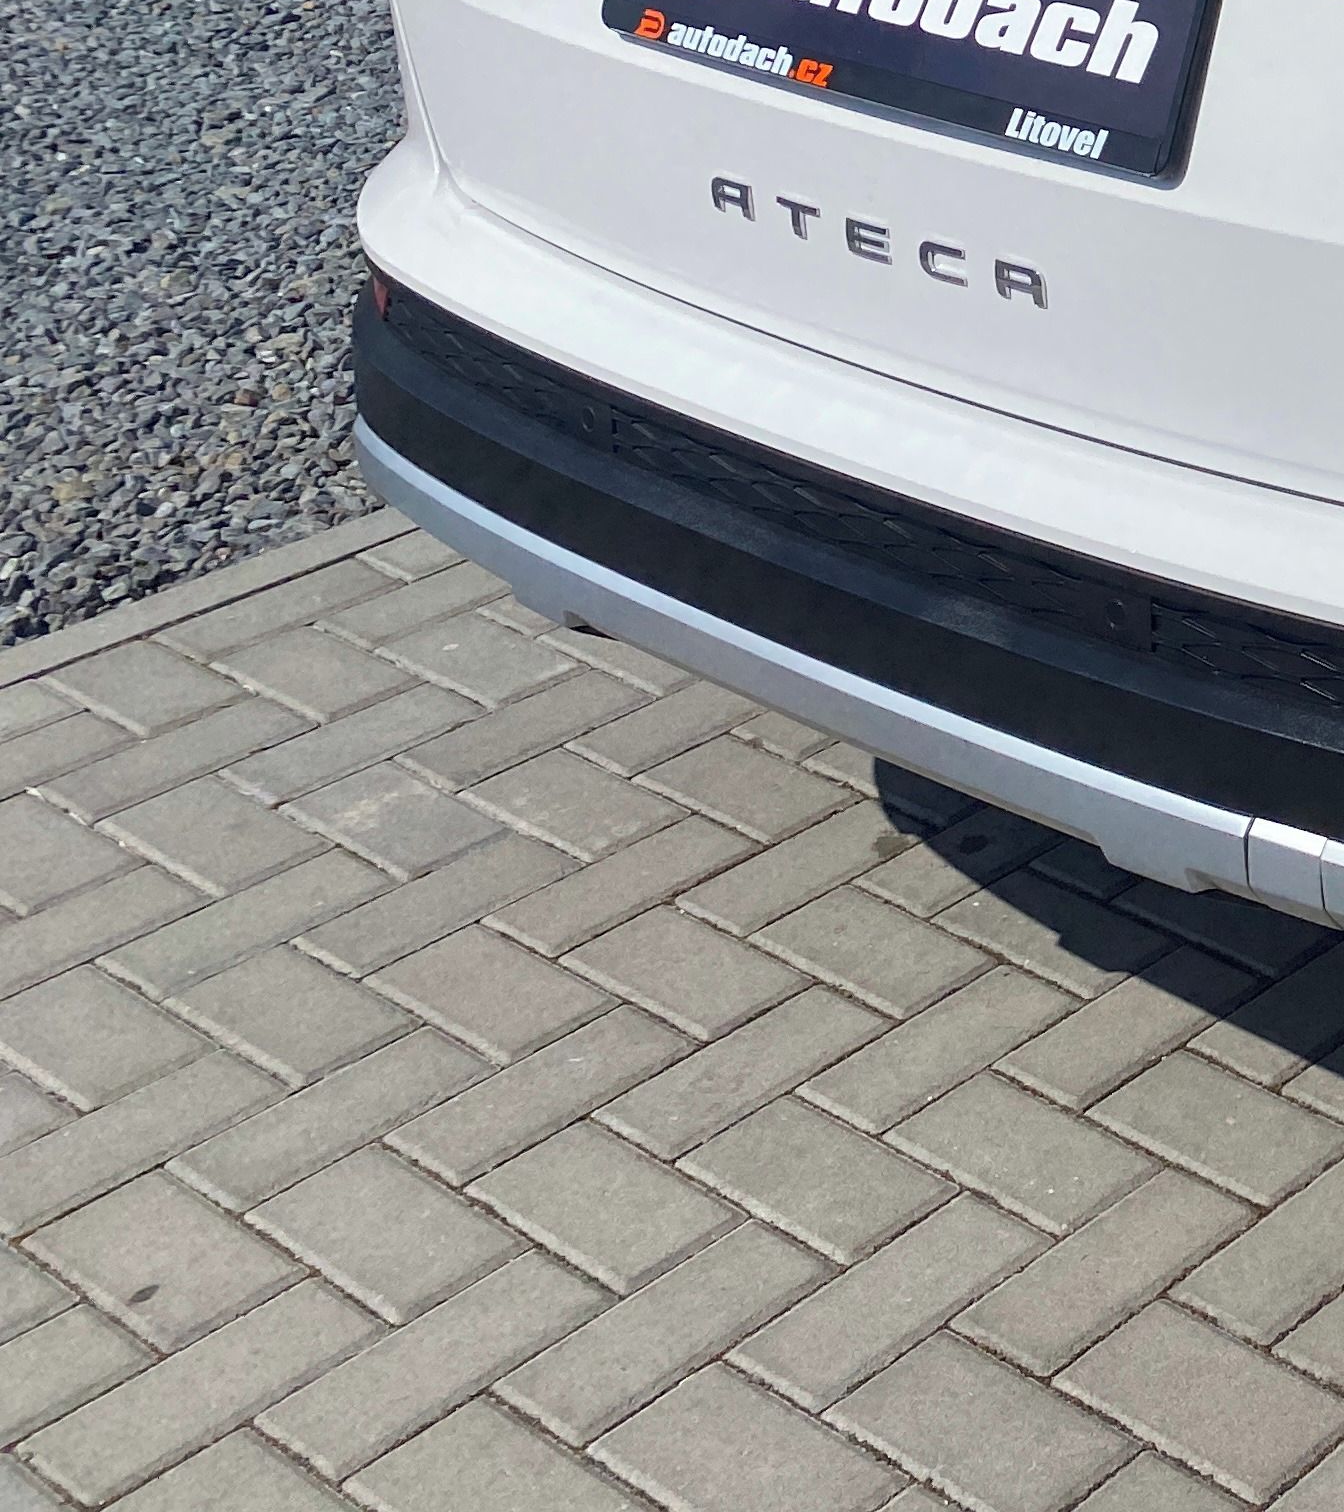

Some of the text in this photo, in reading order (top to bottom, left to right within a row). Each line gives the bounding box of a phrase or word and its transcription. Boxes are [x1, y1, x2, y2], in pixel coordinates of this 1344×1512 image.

[666, 21, 834, 87] autodach.cz
[1005, 107, 1109, 159] Litovel
[710, 175, 1049, 310] ATECA
